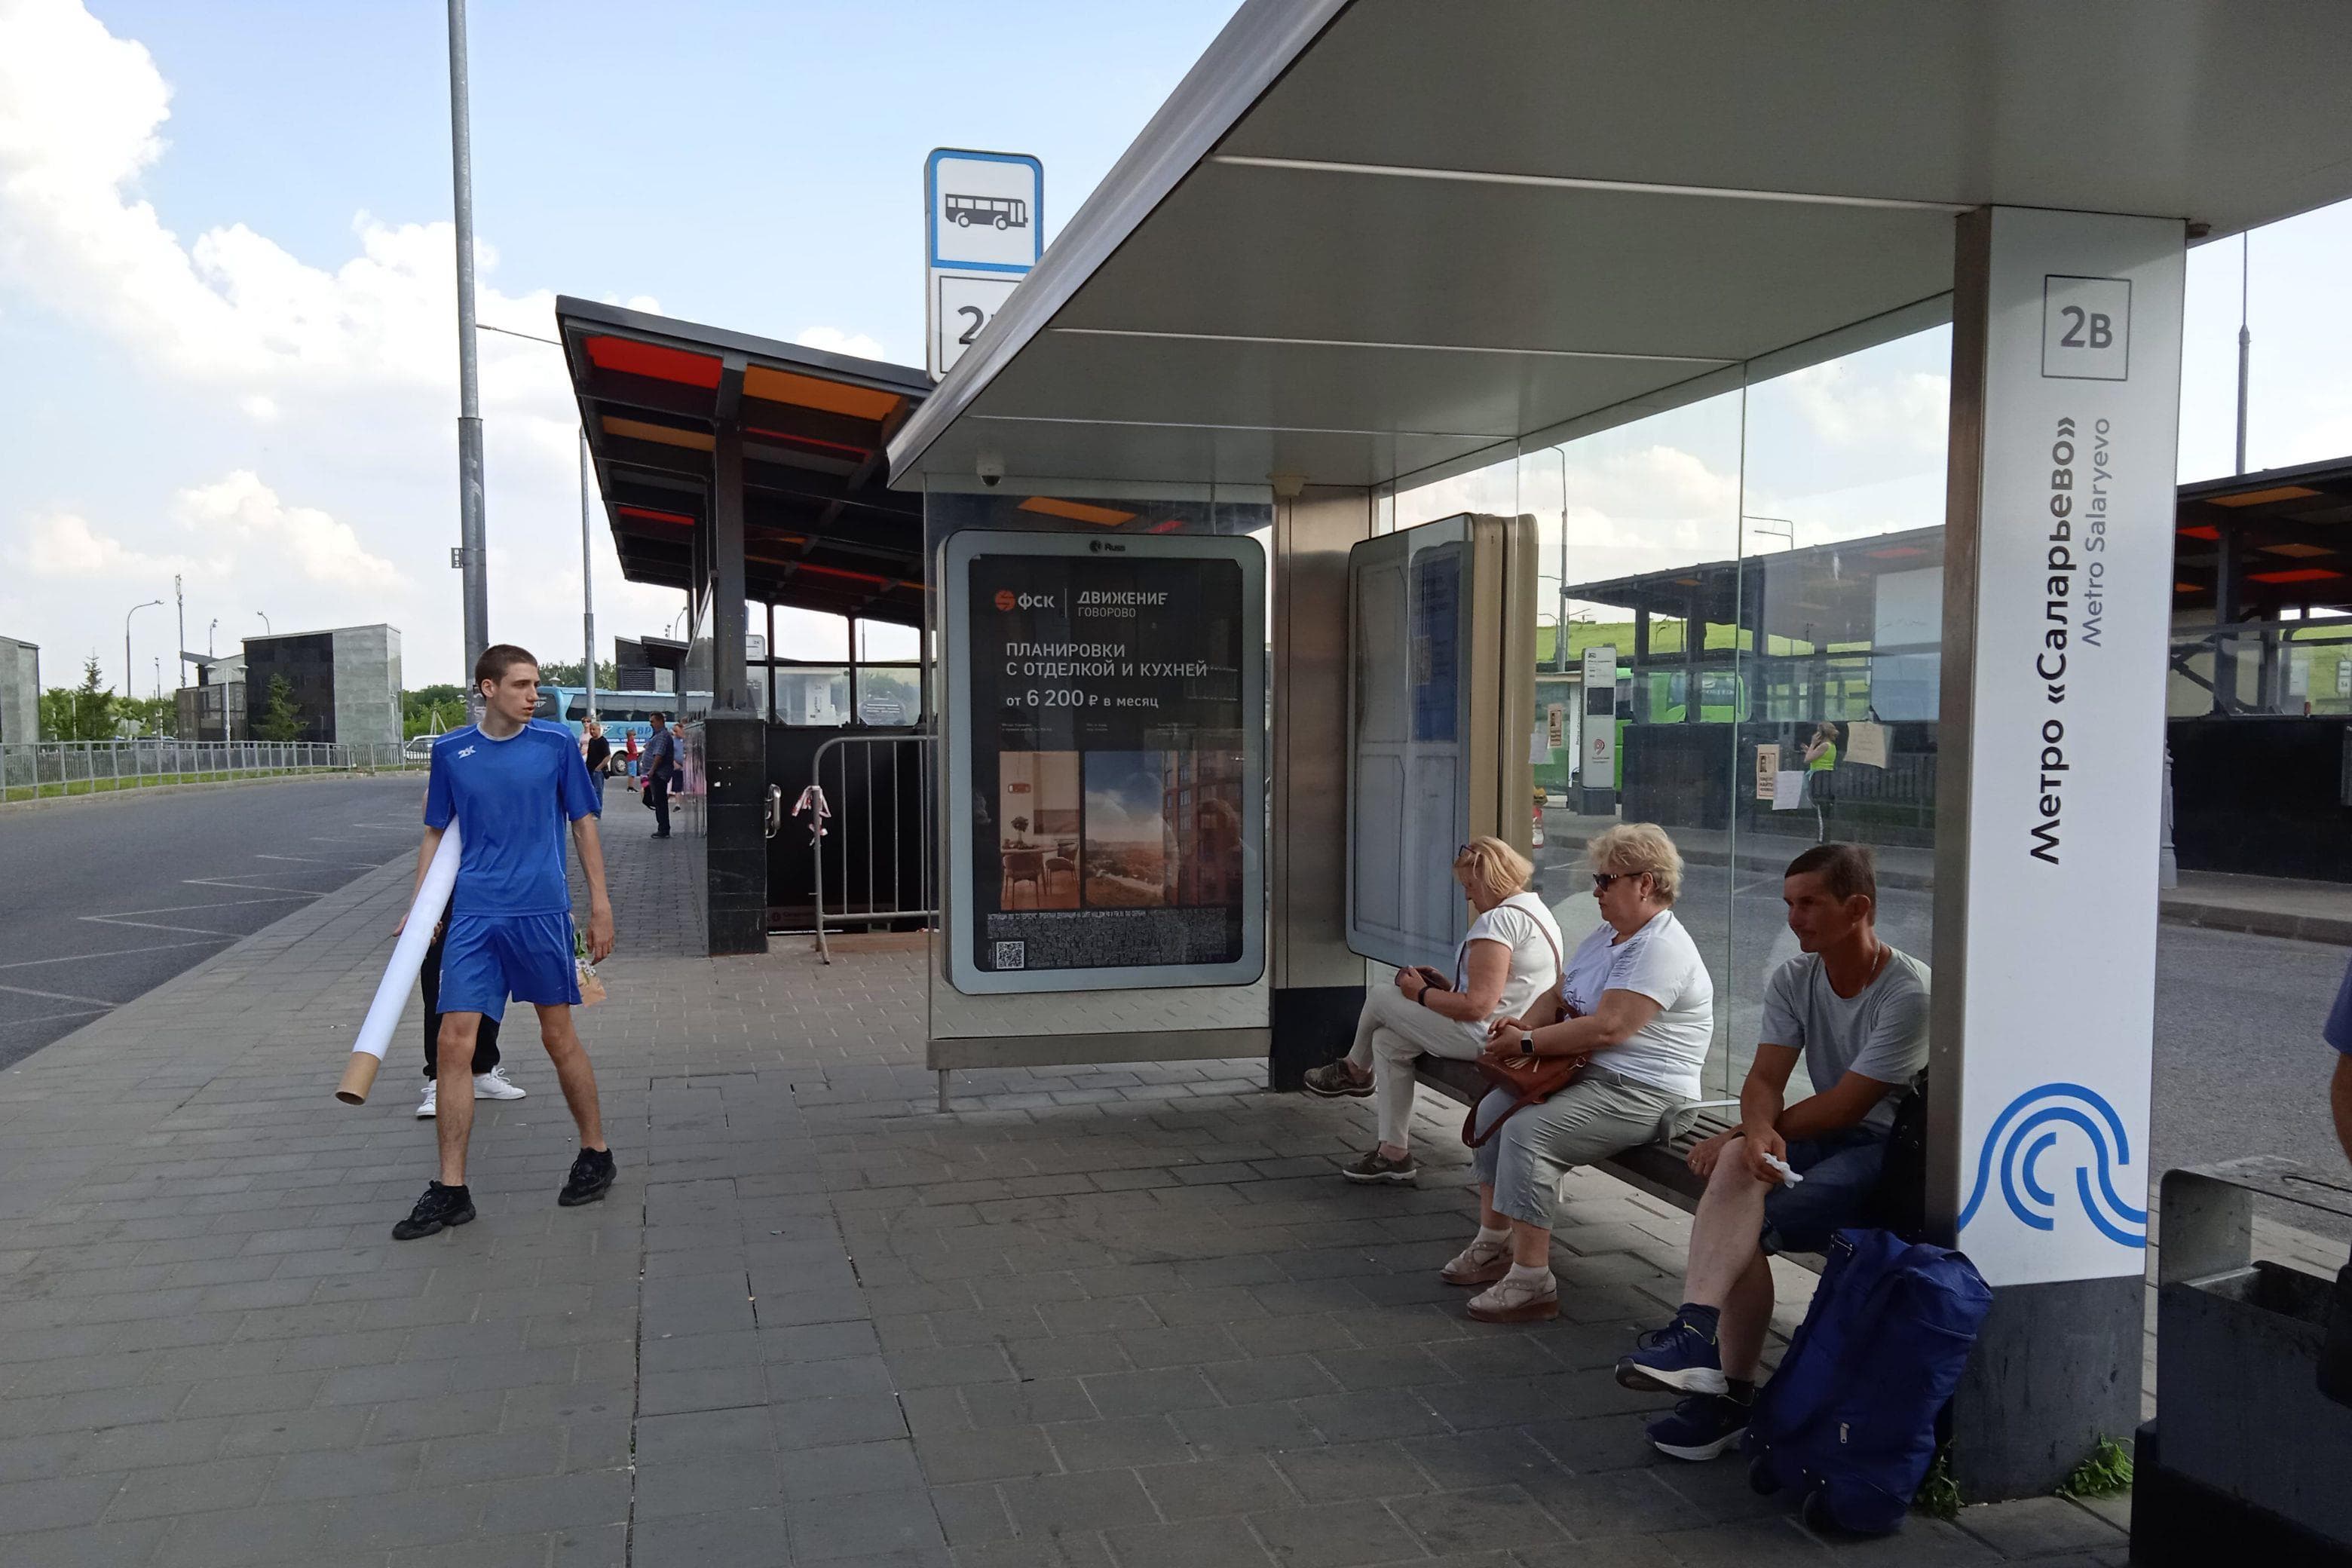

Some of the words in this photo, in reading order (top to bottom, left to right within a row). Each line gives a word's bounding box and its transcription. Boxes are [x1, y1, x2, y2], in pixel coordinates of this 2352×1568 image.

[957, 305, 995, 345] 2
[2085, 418, 2112, 553] Salaryevo
[1104, 543, 1126, 552] Russ
[2036, 417, 2077, 705] «Саларьево»
[1076, 591, 1168, 605] ДВИЖЕНИЕ
[2081, 562, 2105, 648] Metro
[1078, 606, 1136, 618] ГОВОРОВО
[1006, 642, 1125, 658] ПЛАНИРОВКИ
[1023, 660, 1116, 678] ОТДЕЛКОЙ
[1122, 663, 1133, 676] И
[1141, 660, 1207, 677] КУХНЕЙ
[1006, 697, 1021, 706] от
[1104, 698, 1111, 706] в
[1116, 698, 1159, 709] месяц
[2030, 719, 2070, 865] Метро
